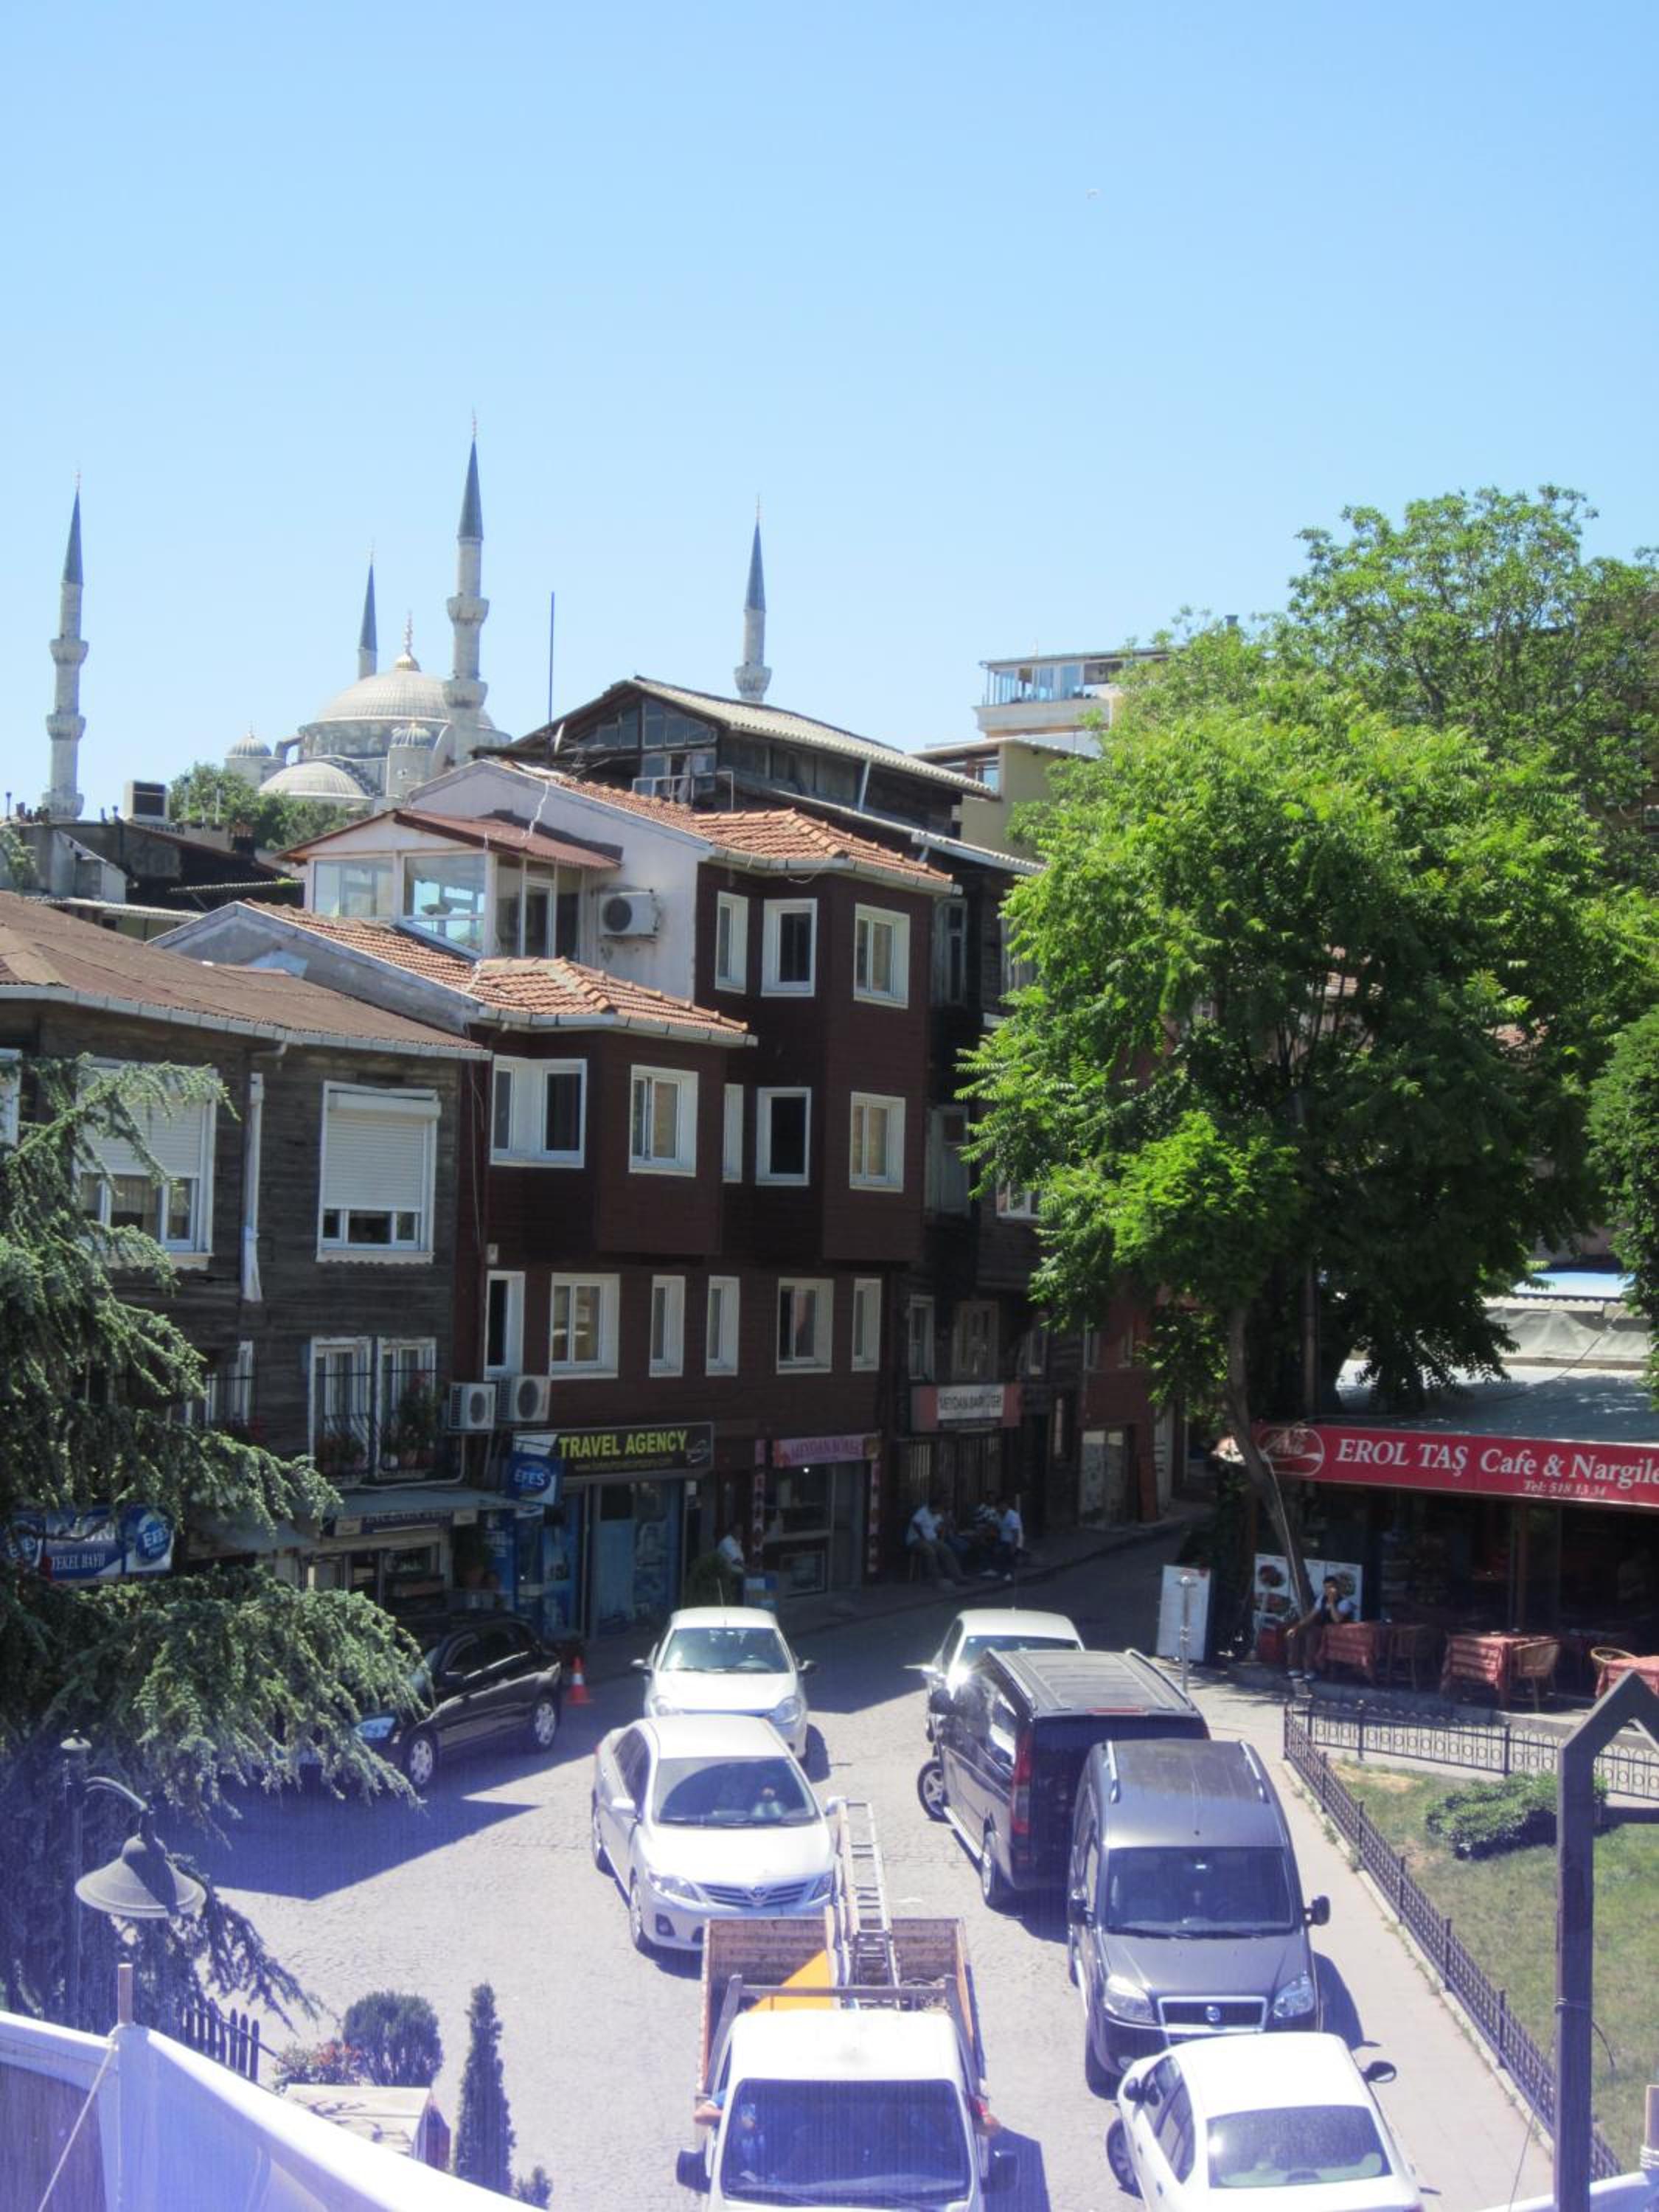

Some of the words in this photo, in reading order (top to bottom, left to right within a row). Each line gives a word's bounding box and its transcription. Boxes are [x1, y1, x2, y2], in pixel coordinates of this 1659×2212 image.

[558, 1434, 621, 1458] TRAVEL
[625, 1430, 687, 1455] AGENCY
[1335, 1439, 1410, 1466] EROL
[1417, 1443, 1468, 1477] TAŞ
[1480, 1448, 1537, 1475] Cafe
[1543, 1454, 1565, 1478] &
[1569, 1453, 1659, 1489] Nargile
